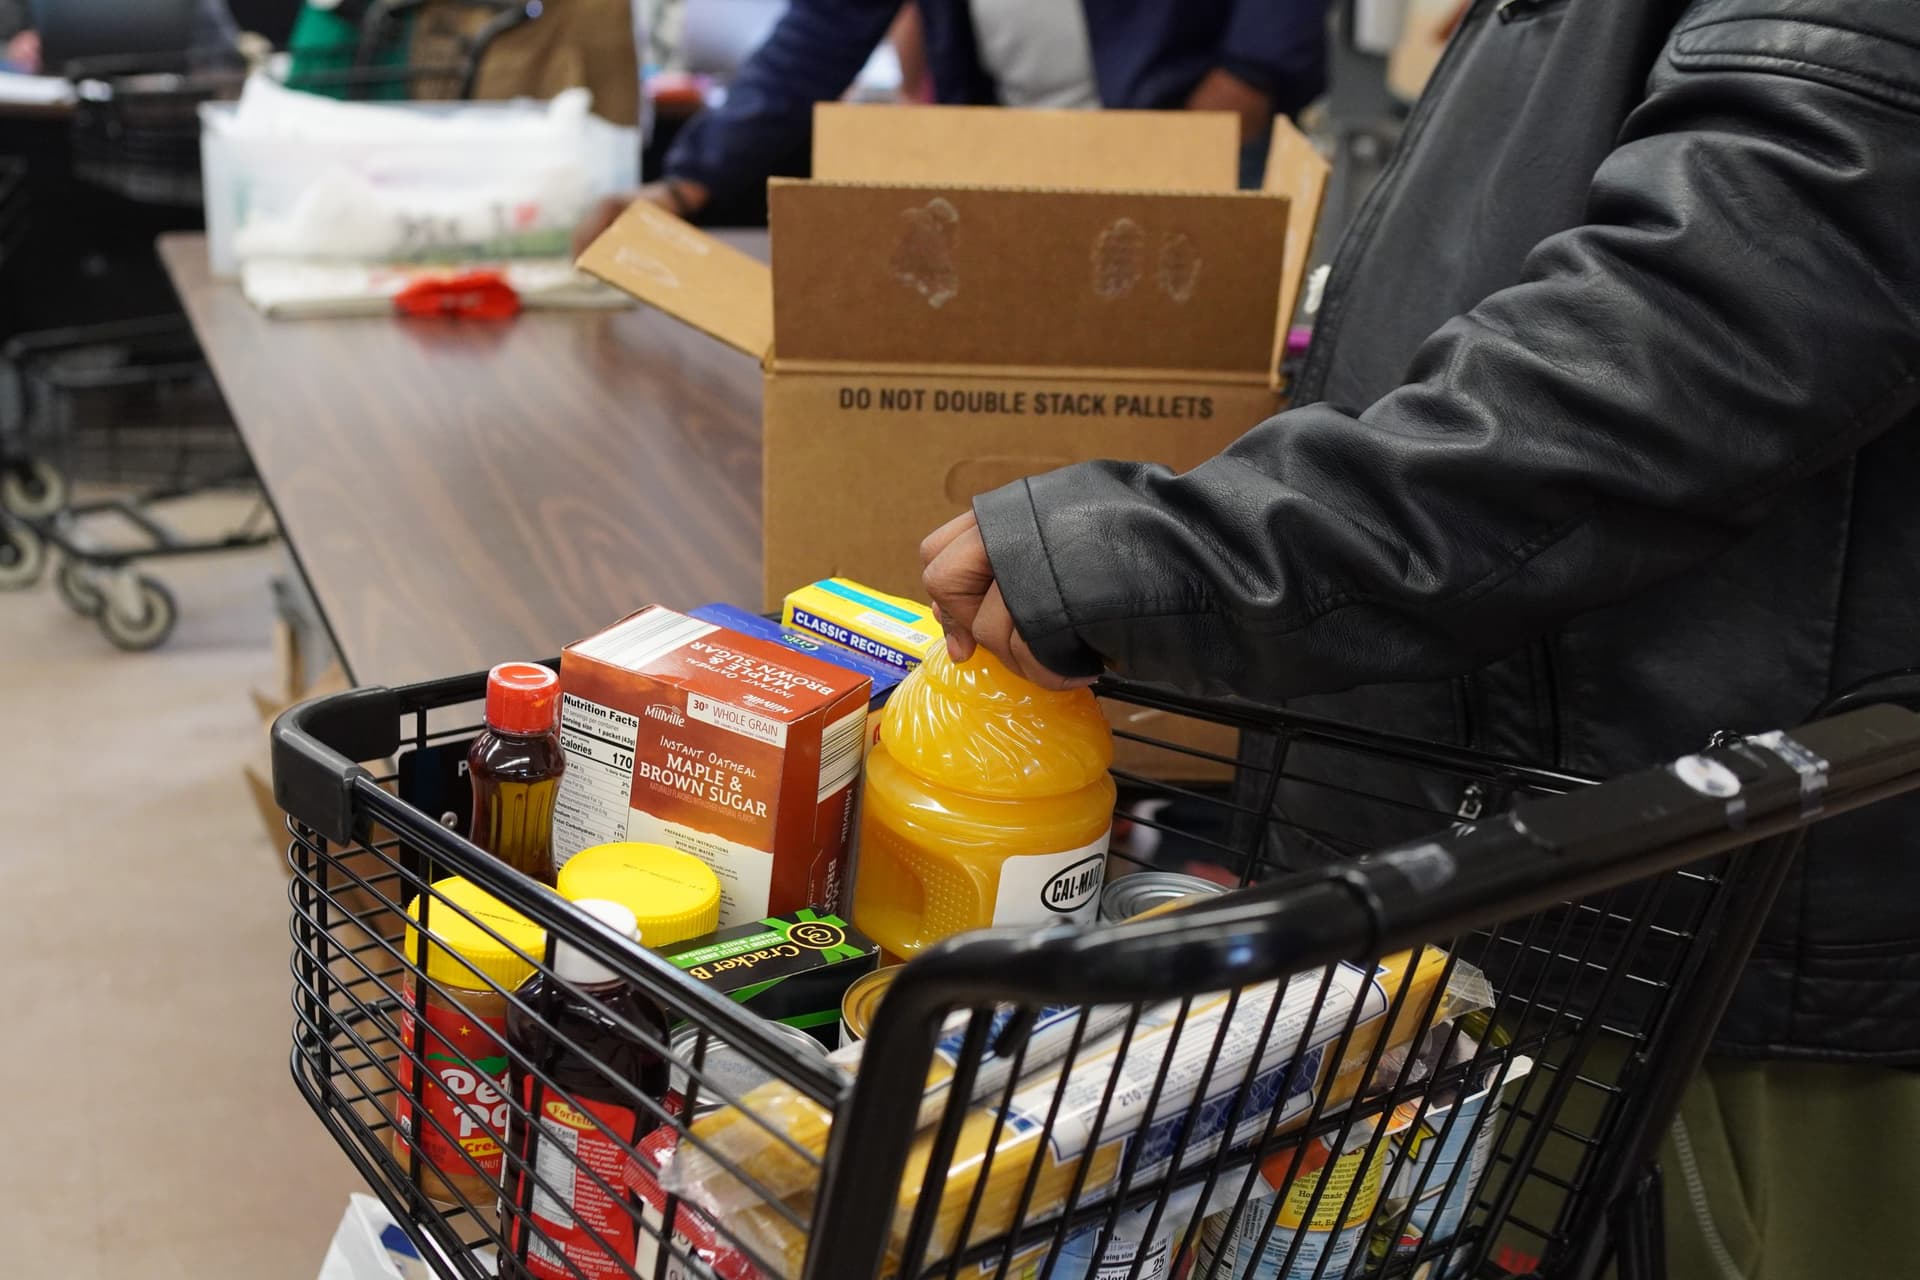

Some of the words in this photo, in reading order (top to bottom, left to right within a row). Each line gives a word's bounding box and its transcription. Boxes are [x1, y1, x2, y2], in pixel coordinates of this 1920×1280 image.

[840, 388, 871, 410] DO
[880, 389, 925, 411] NOT
[934, 390, 1025, 414] DOUBLE
[1034, 392, 1106, 416] STACK
[1114, 395, 1214, 420] PALLETS
[690, 640, 757, 667] SUGAR
[795, 612, 848, 642] CLASSIC
[850, 634, 904, 666] RECIPES
[685, 658, 738, 678] OATMEAL
[709, 655, 725, 665] &
[726, 662, 796, 689] MAPLE
[741, 679, 795, 698] INSTANT
[758, 665, 836, 696] BROWN
[564, 695, 607, 718] Nutrition
[609, 711, 638, 728] Facts
[645, 705, 685, 728] Millville
[713, 706, 746, 726] WHOLE
[748, 718, 778, 736] GRAIN
[561, 736, 592, 755] Calories
[613, 752, 633, 769] 170
[660, 736, 704, 759] INSTANT
[708, 752, 756, 778] OATMEAL
[666, 753, 725, 787] MAPLE
[729, 776, 743, 793] &
[640, 762, 704, 797] BROWN
[709, 787, 767, 818] SUGAR
[713, 944, 800, 972] Cracker
[1118, 1090, 1142, 1106] 210
